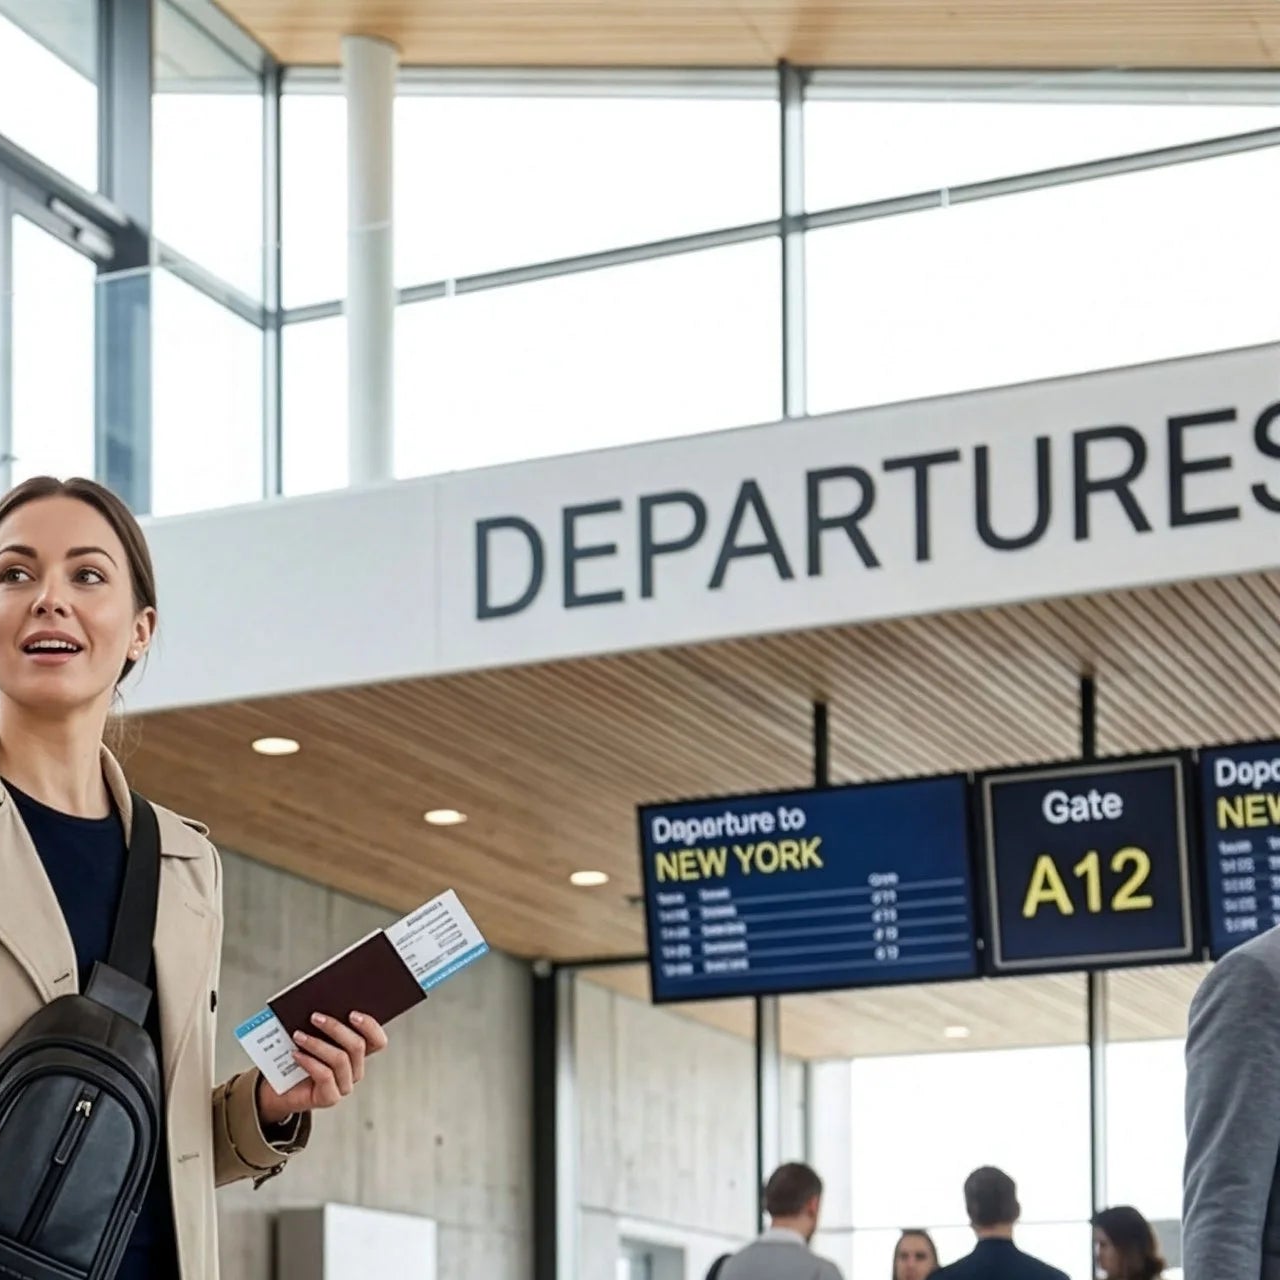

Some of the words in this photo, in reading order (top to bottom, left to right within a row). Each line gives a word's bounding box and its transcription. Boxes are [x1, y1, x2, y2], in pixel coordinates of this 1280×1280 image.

[777, 806, 806, 831] to
[1042, 789, 1124, 824] Gate
[655, 846, 727, 882] NEW
[732, 836, 824, 875] YORK
[1023, 847, 1153, 917] A12
